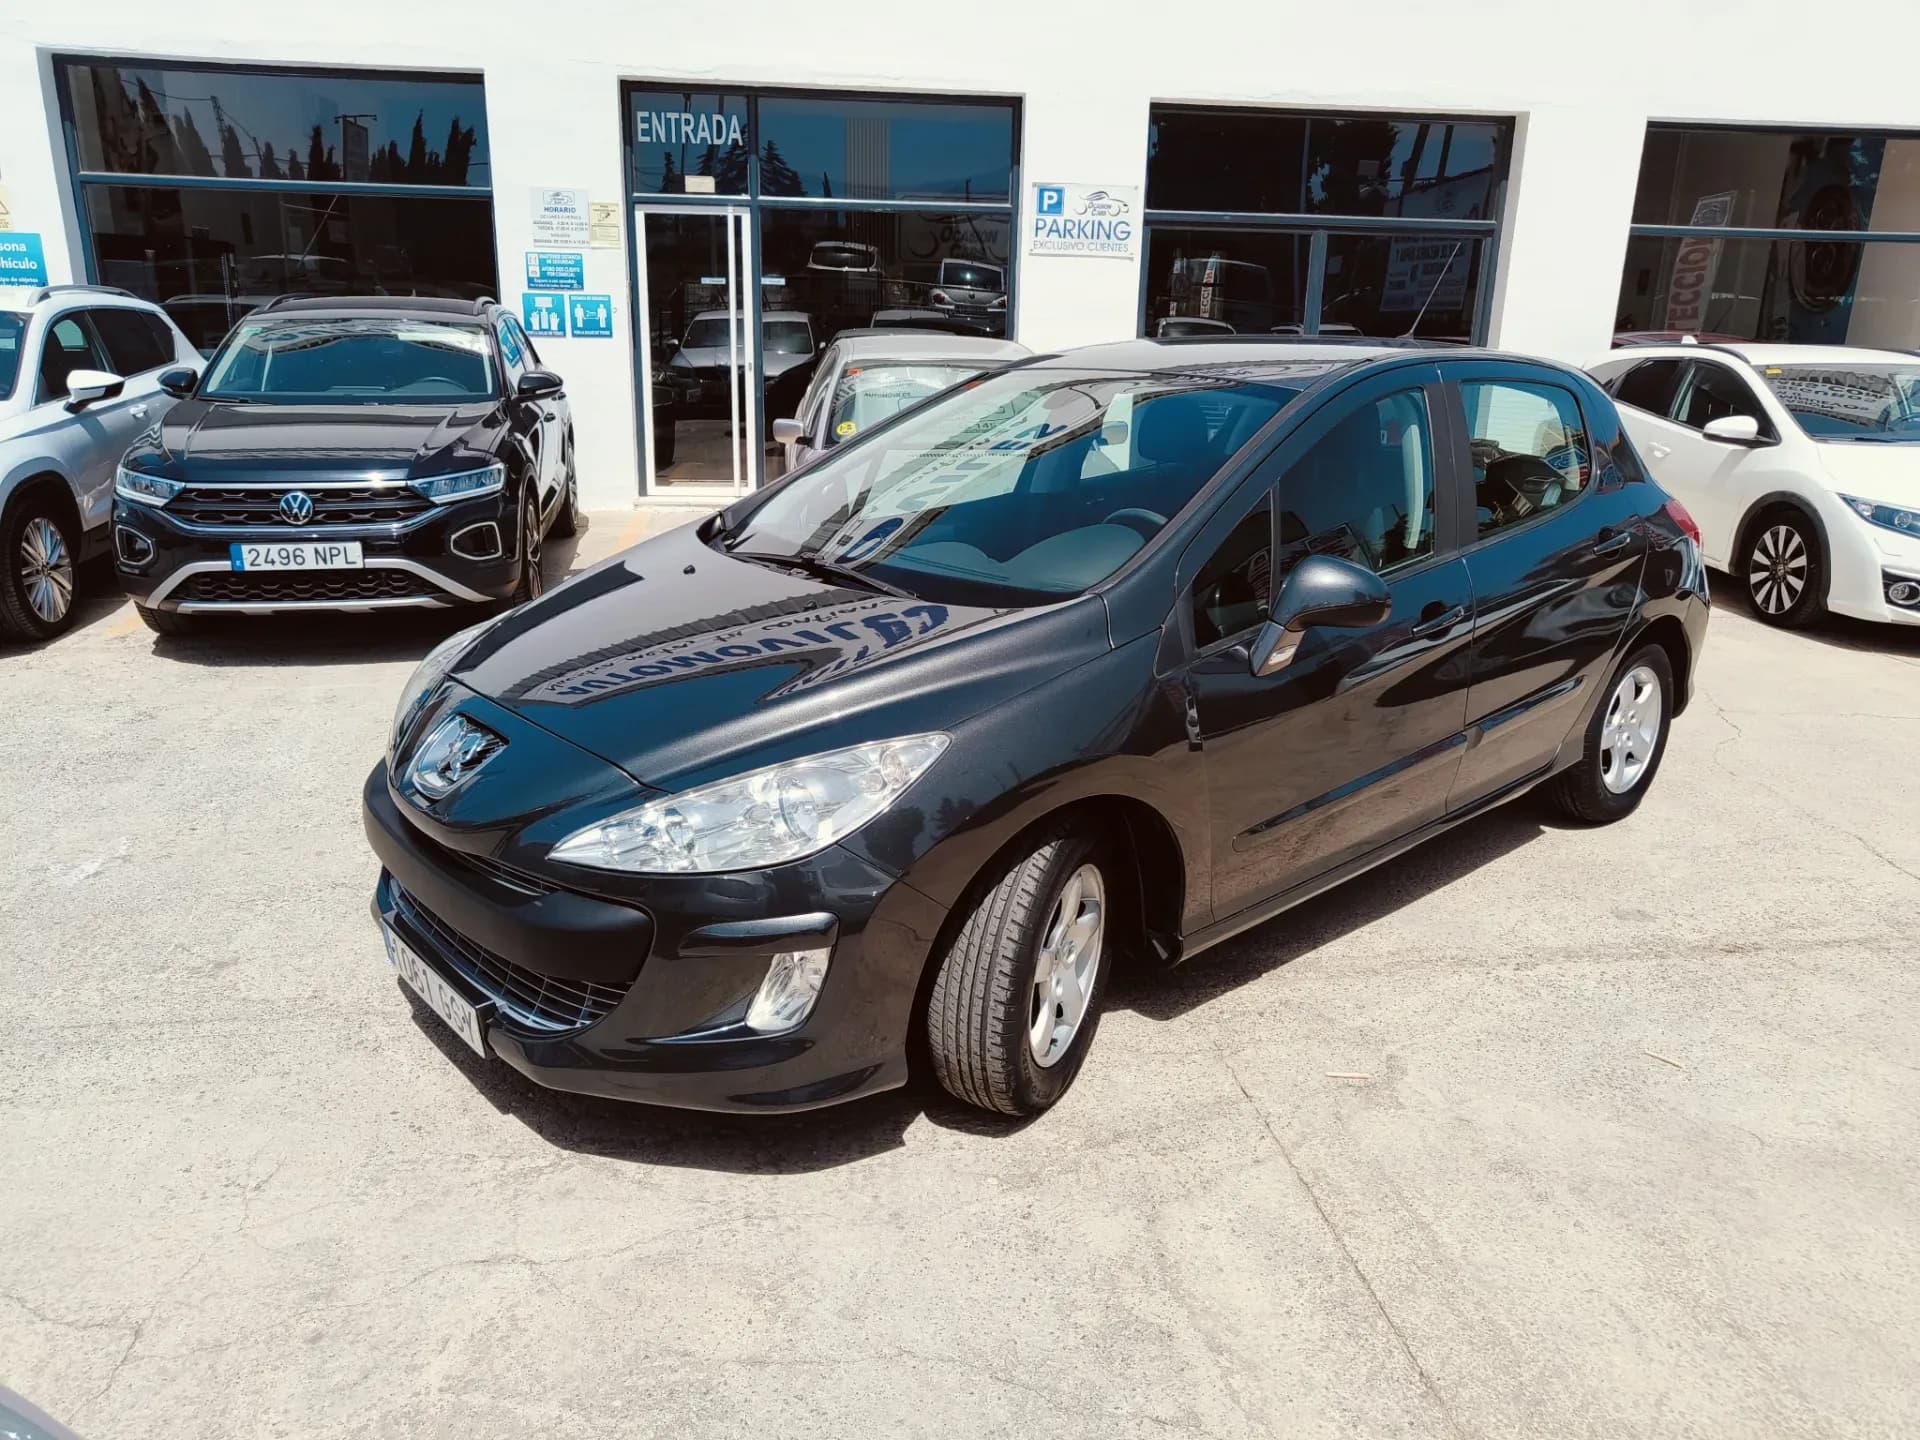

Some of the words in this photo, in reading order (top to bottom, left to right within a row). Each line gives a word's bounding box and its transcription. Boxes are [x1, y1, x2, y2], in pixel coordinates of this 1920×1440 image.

[636, 111, 743, 146] ENTRADA
[544, 206, 576, 214] HORARIO
[1042, 191, 1058, 211] P
[1035, 218, 1132, 241] PARKING
[1033, 240, 1085, 251] EXCLUSIVO
[1086, 242, 1129, 253] CLIENTES
[0, 257, 38, 270] hículo
[247, 547, 307, 567] 2496
[313, 546, 357, 565] NPL
